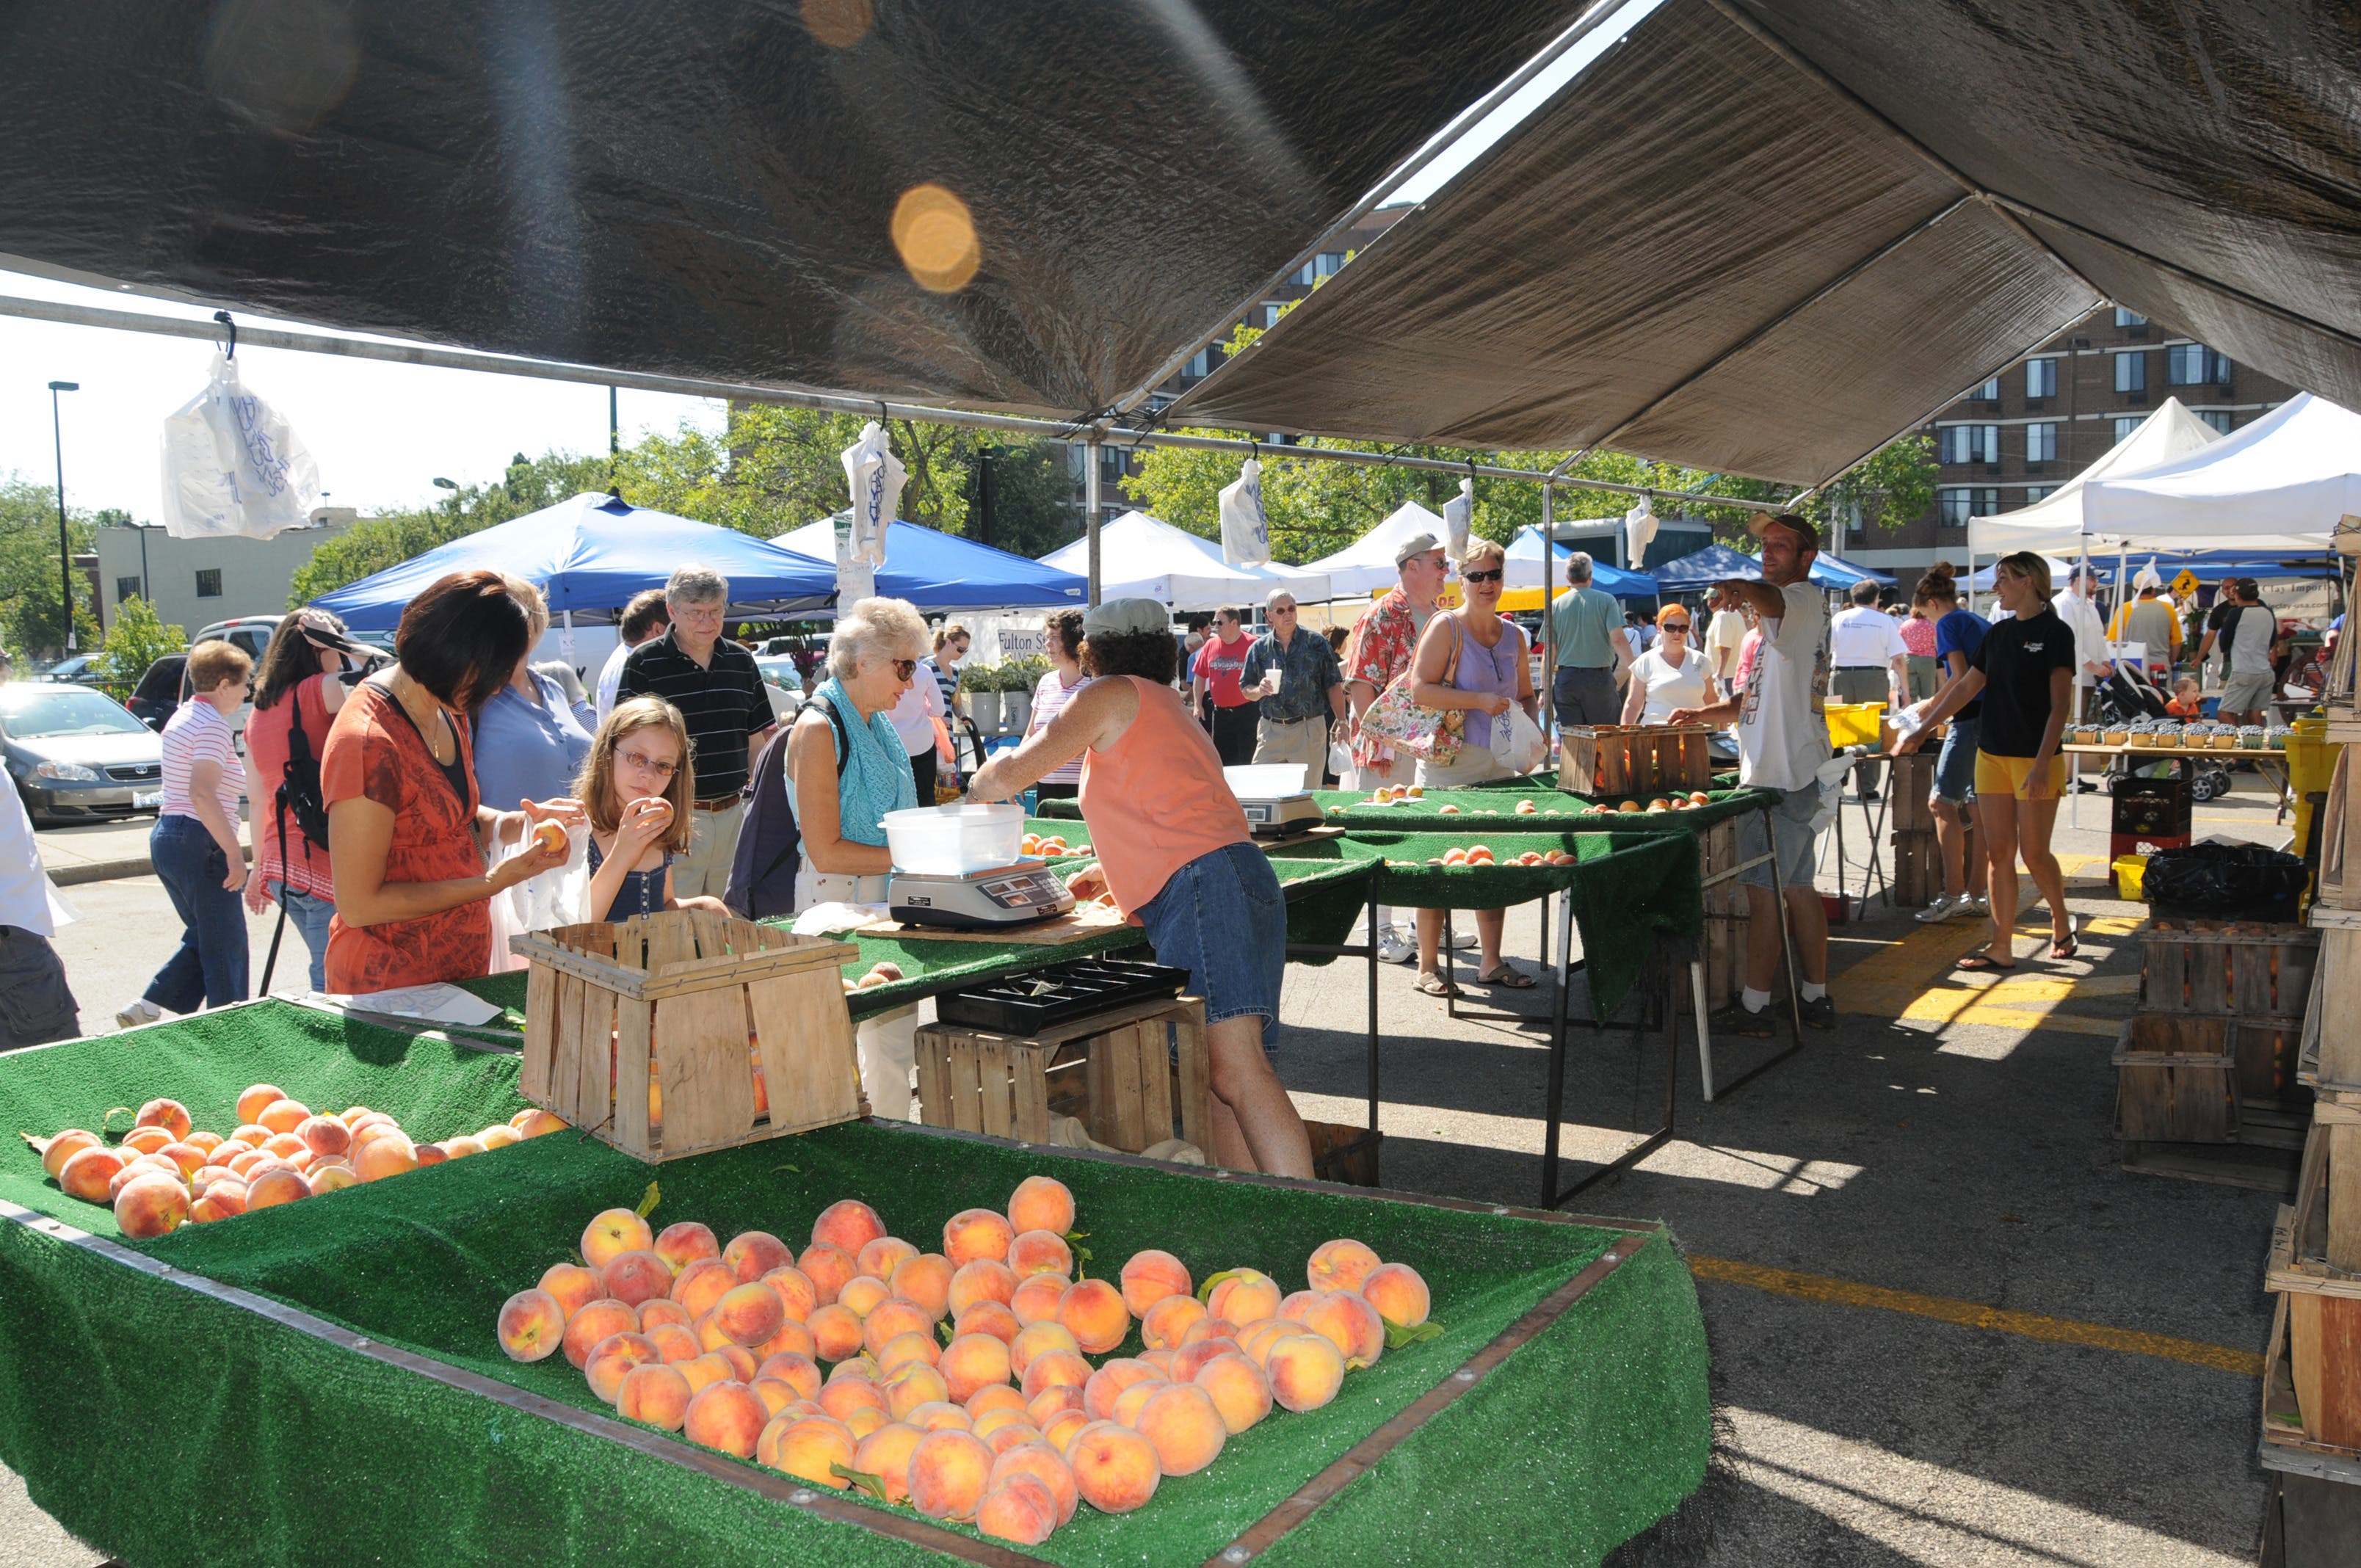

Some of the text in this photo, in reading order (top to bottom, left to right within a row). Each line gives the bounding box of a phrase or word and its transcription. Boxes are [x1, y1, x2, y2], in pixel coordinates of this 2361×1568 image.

[2262, 582, 2327, 594] Clay Import
[998, 633, 1046, 650] Fulton St
